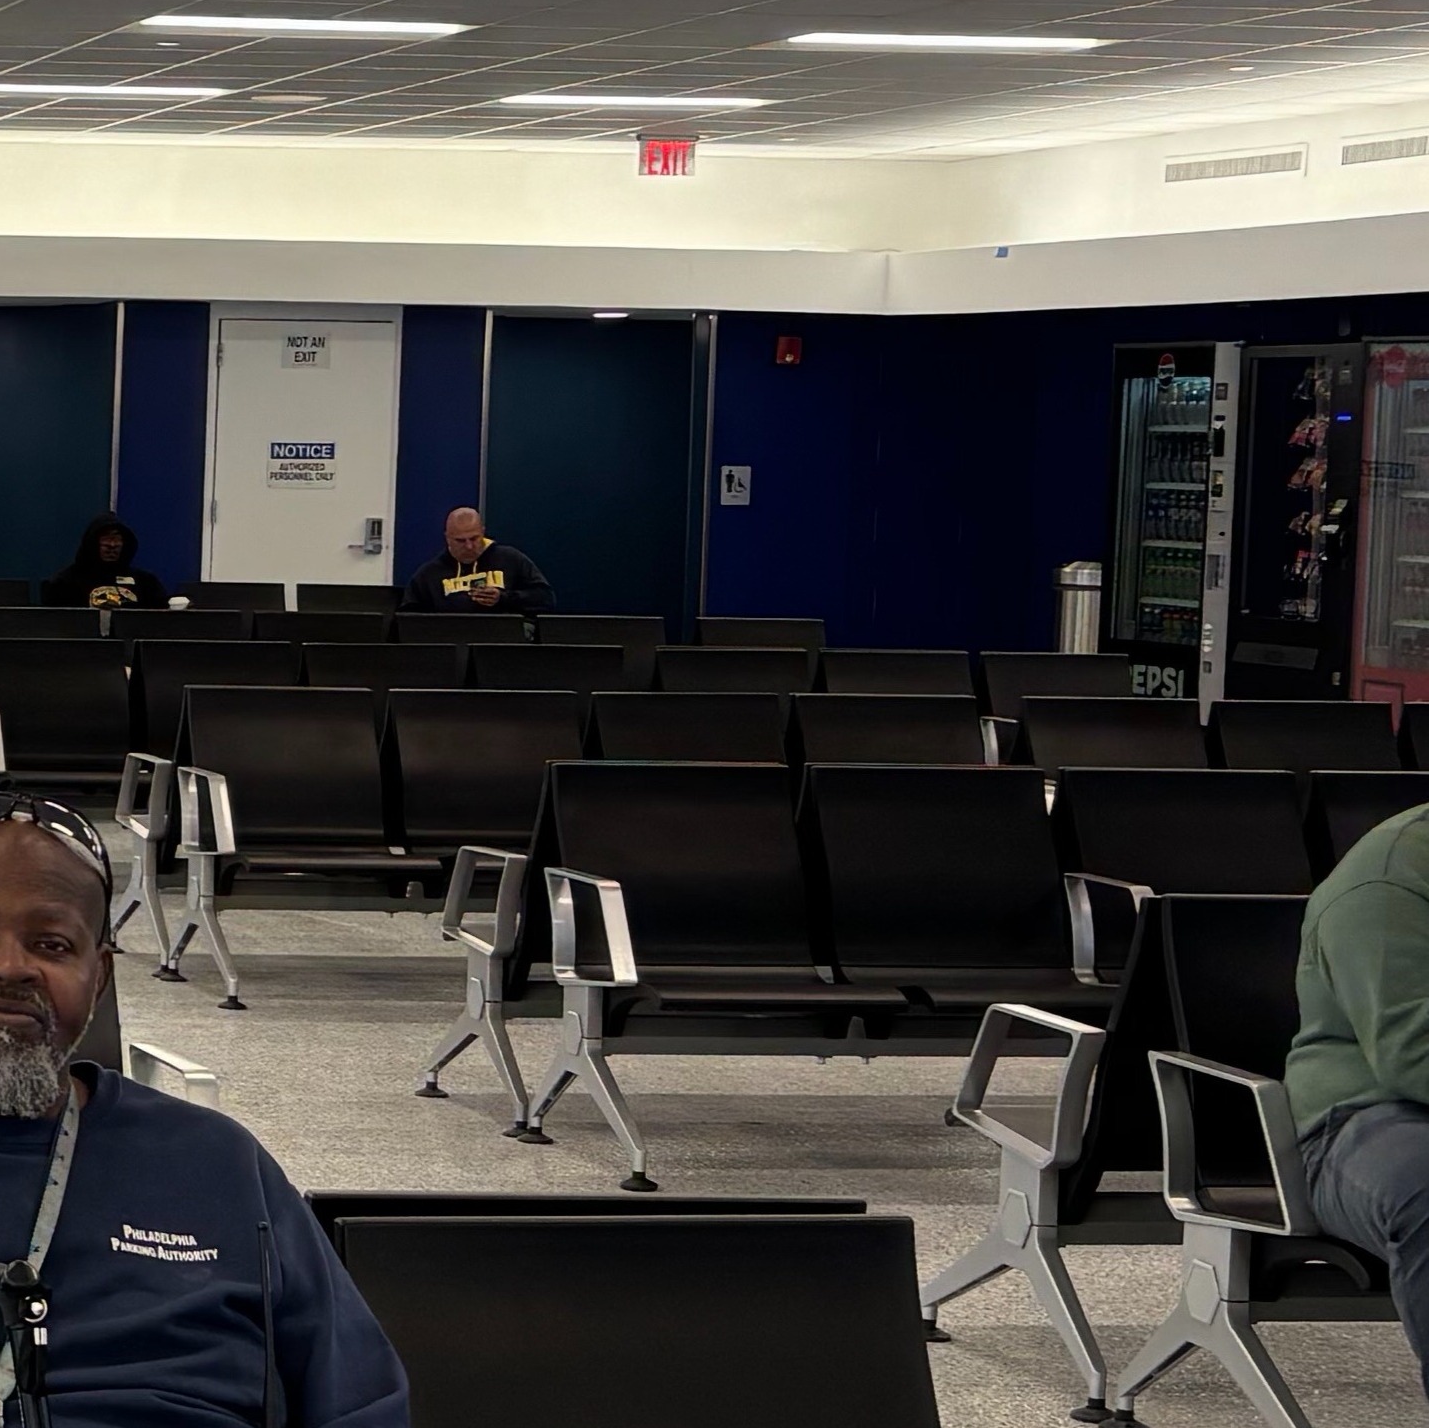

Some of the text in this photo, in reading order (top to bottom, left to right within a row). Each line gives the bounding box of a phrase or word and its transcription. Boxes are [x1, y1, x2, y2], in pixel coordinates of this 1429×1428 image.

[645, 141, 691, 175] EXIT
[286, 336, 326, 348] NOT AN
[294, 351, 317, 362] EXIT
[272, 444, 332, 458] NOTICE
[1129, 664, 1185, 698] EPSI
